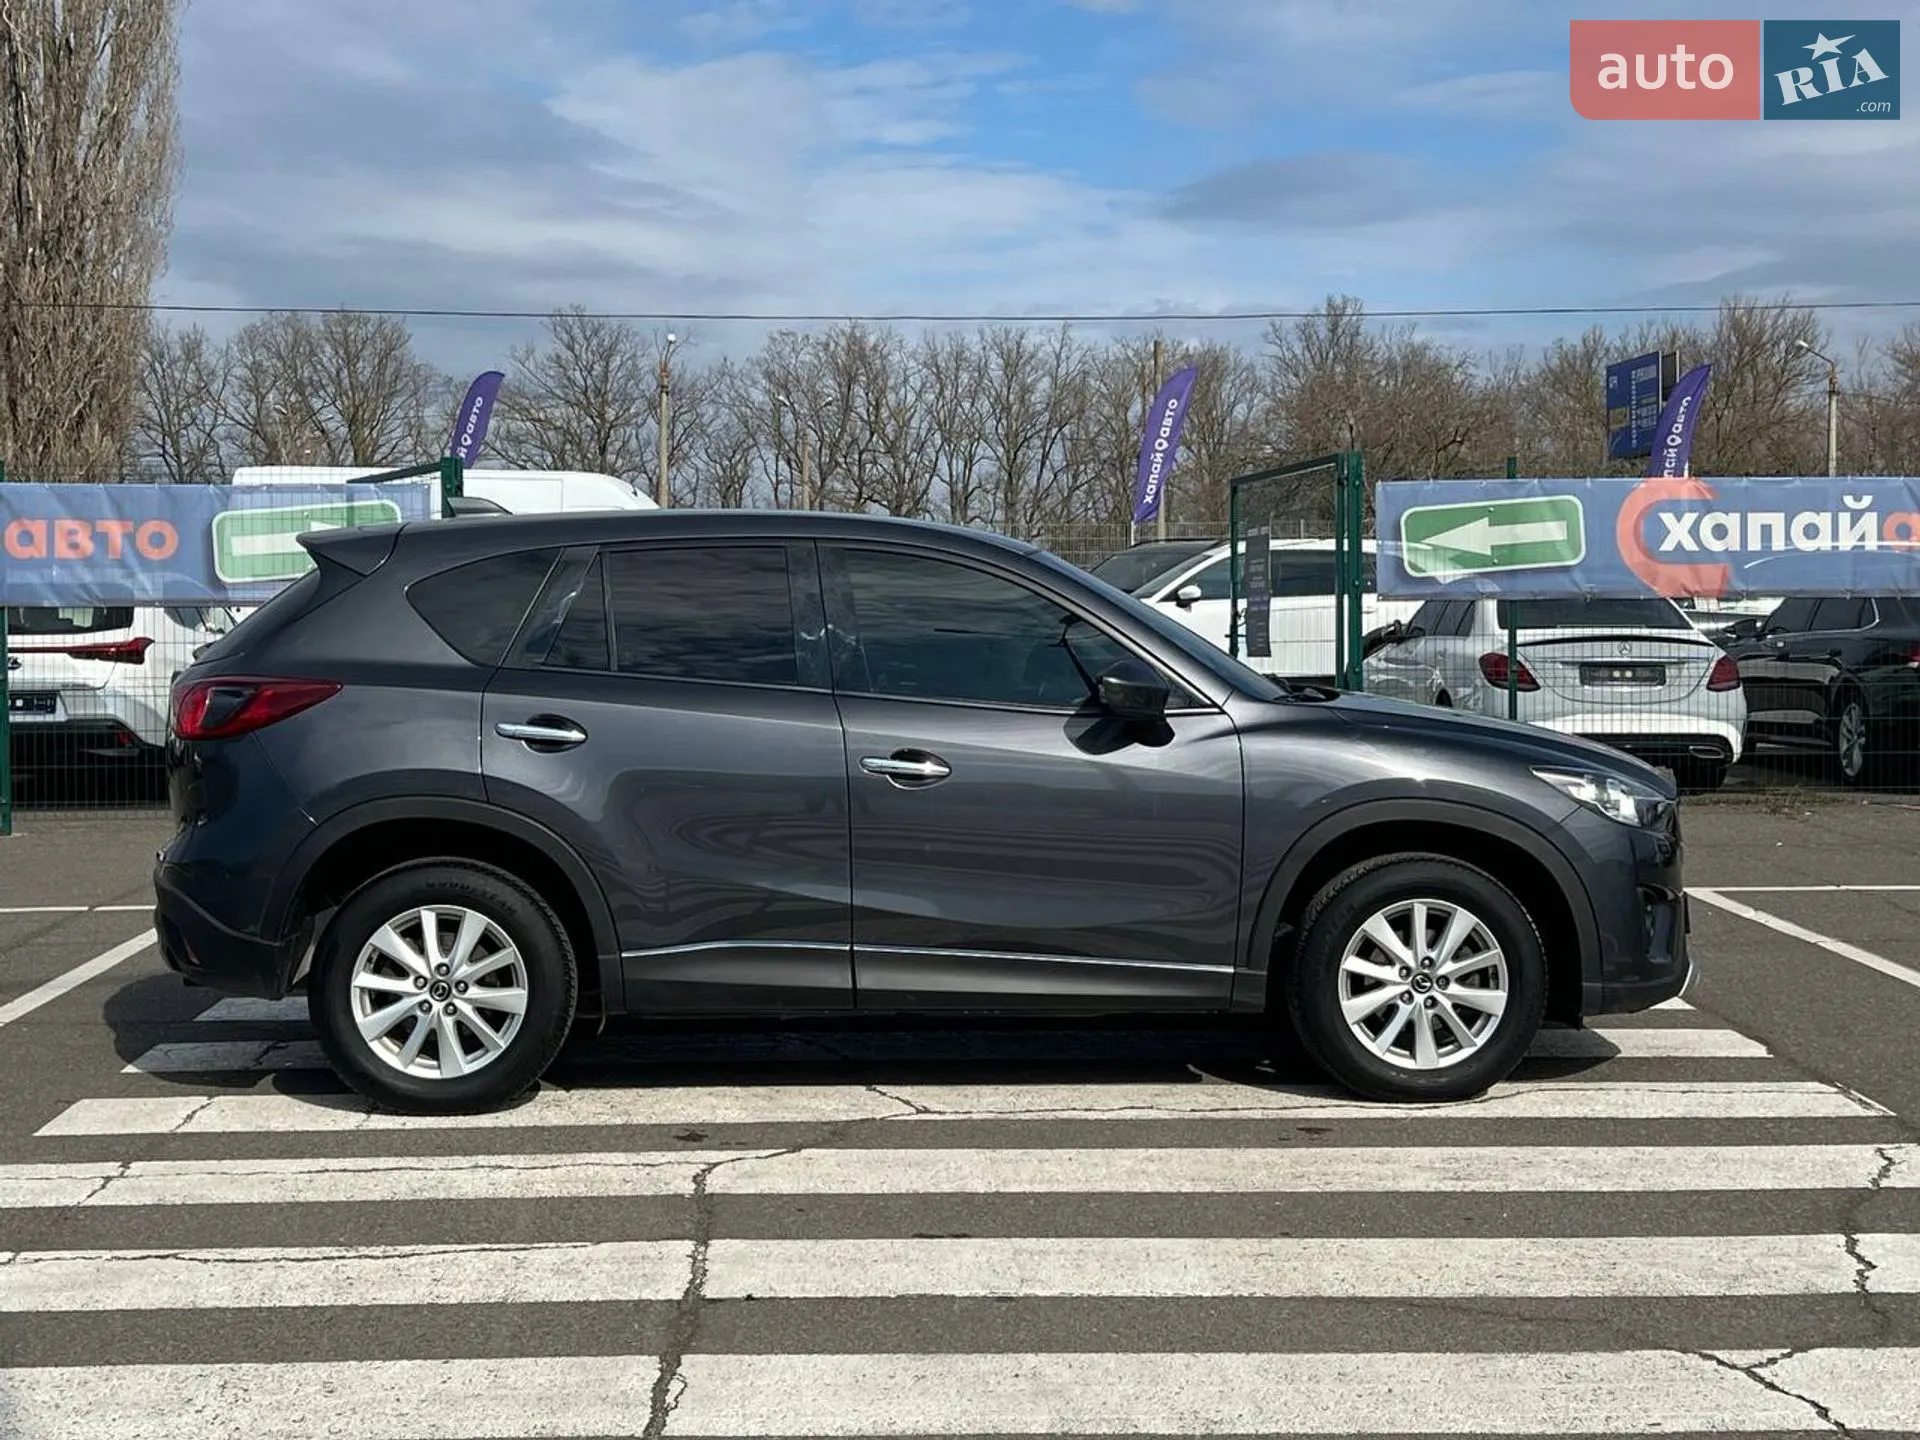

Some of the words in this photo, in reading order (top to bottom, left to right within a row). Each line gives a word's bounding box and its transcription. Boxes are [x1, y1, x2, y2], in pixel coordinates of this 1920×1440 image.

[466, 396, 483, 434] авто
[1143, 452, 1165, 504] хапай
[1160, 398, 1178, 438] авто
[4, 518, 179, 560] авто
